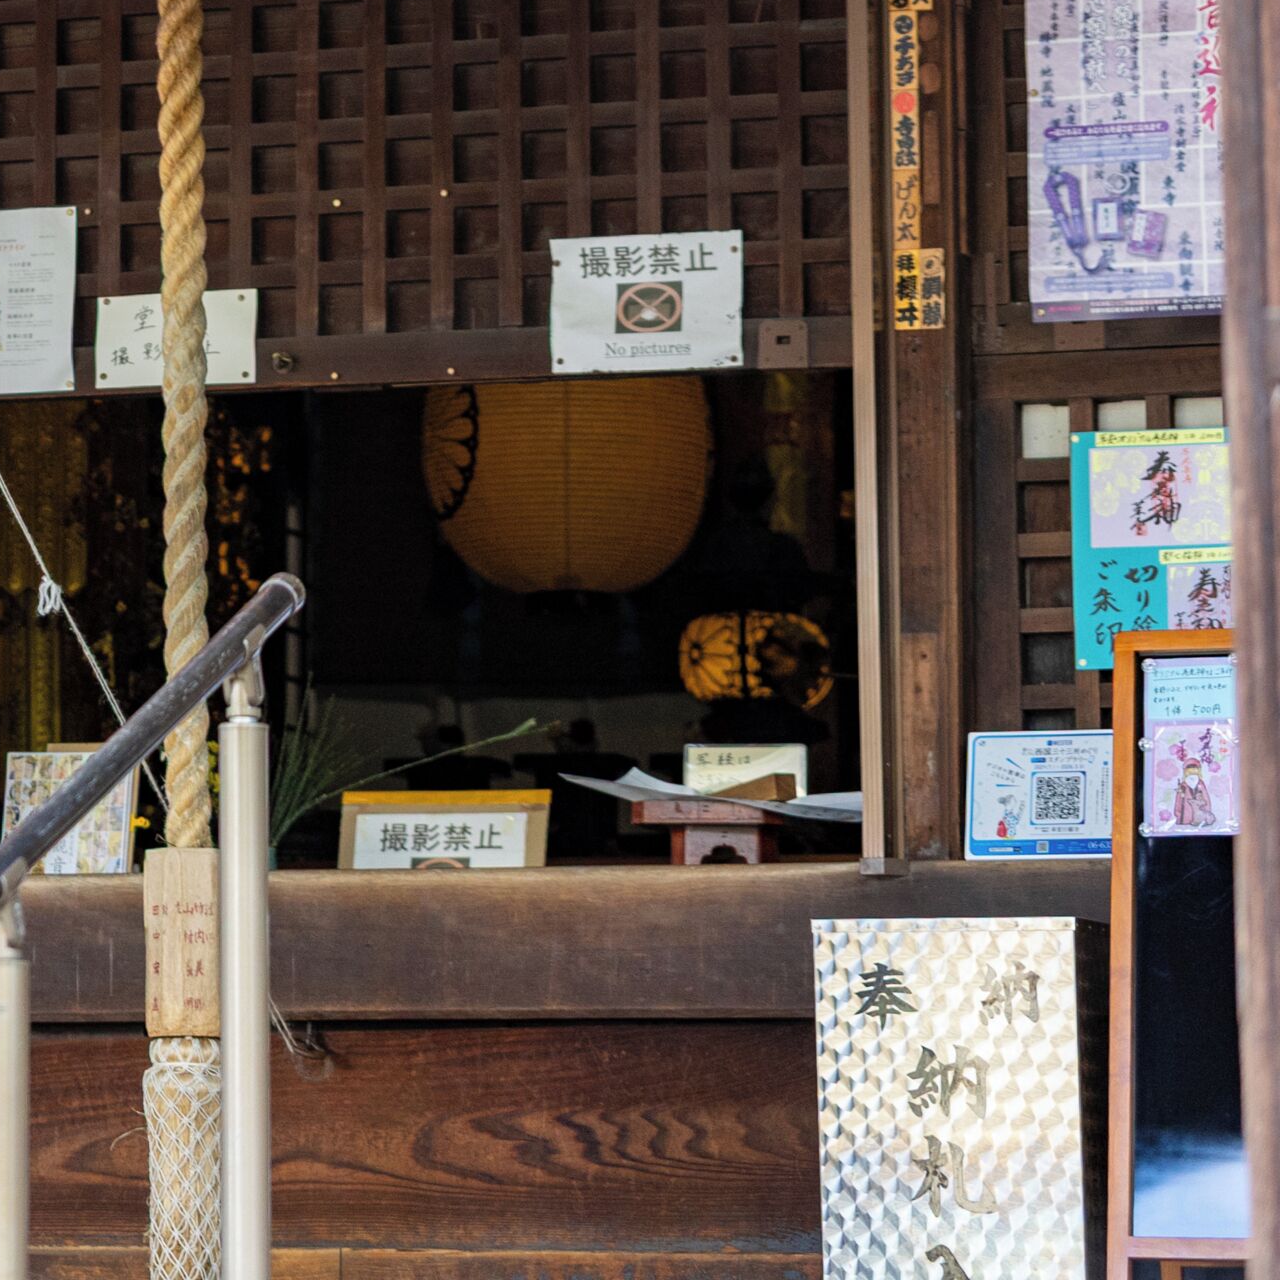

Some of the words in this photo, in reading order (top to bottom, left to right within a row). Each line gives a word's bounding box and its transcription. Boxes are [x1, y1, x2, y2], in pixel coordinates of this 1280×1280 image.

[579, 242, 718, 279] 撮影禁止
[110, 336, 221, 367] 撮影止
[604, 342, 627, 357] No
[630, 341, 692, 358] pictures
[379, 822, 504, 852] 撮影禁止
[854, 960, 1041, 1031] 奉納
